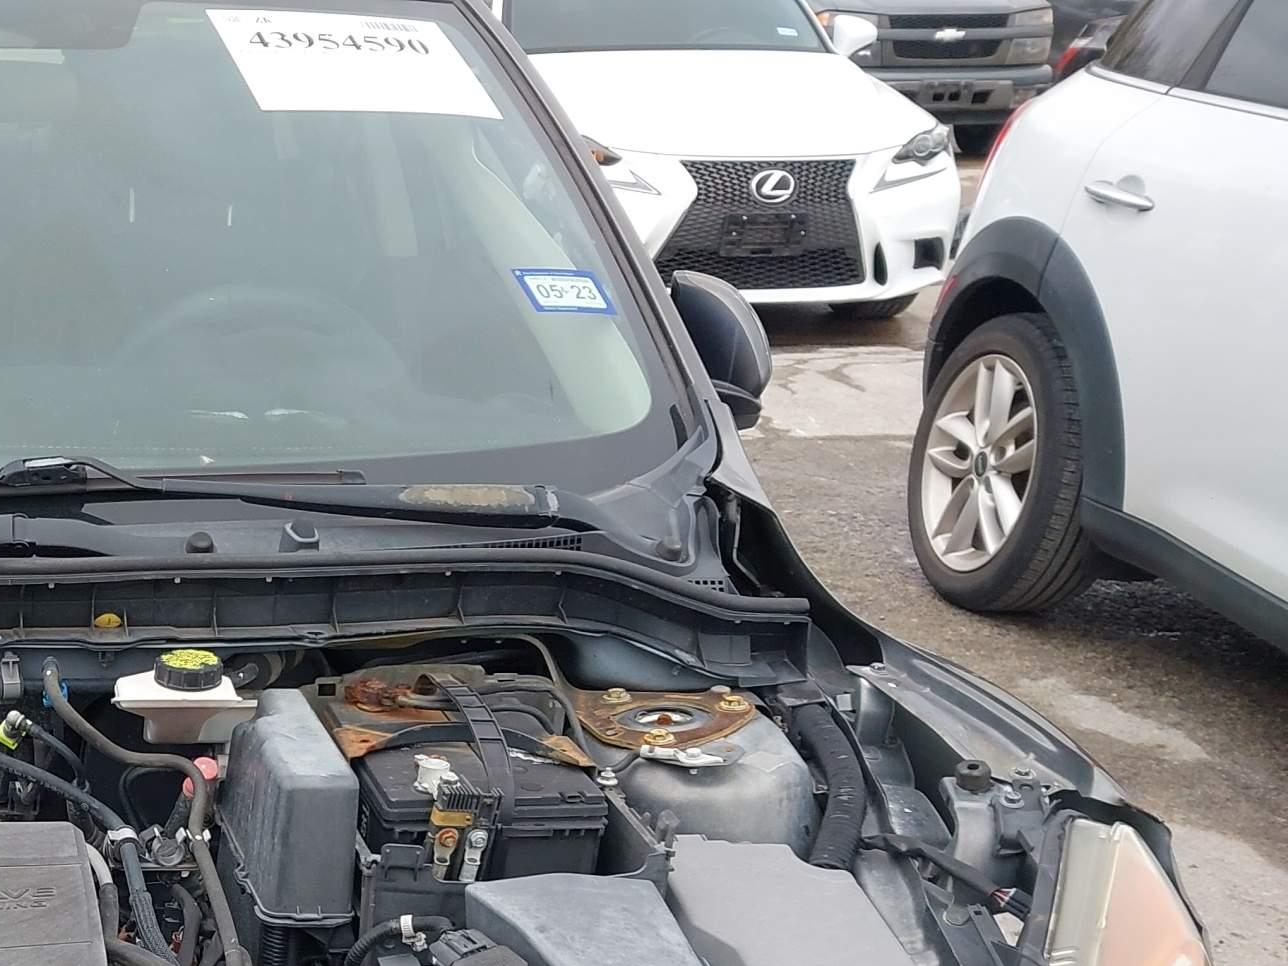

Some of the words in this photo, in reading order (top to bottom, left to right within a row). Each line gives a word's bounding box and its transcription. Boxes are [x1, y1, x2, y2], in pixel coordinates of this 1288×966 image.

[249, 31, 430, 55] 43954590
[536, 284, 564, 299] 05
[570, 285, 597, 300] 23
